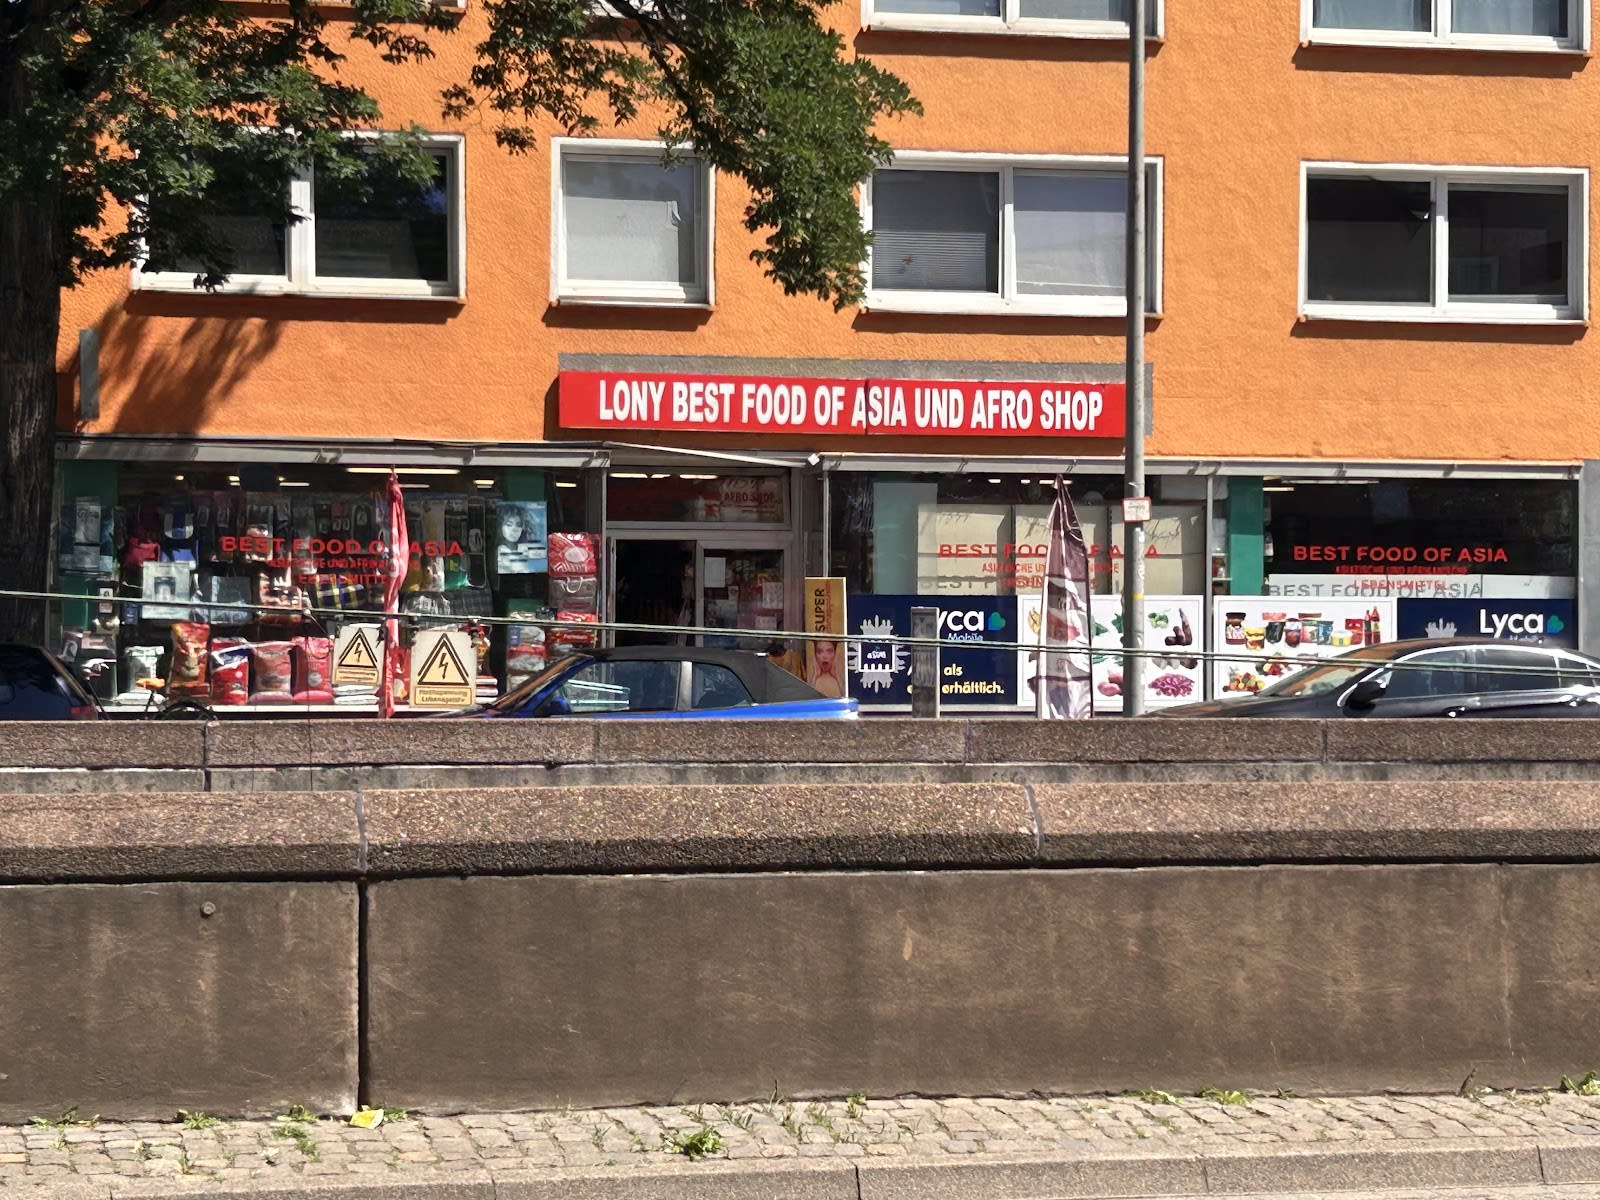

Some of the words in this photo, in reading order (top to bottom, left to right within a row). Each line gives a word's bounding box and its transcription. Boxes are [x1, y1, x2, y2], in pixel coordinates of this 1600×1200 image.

[599, 380, 666, 421] LONY
[672, 382, 736, 424] BEST
[741, 384, 807, 425] FOOD
[813, 386, 846, 427] OF
[851, 386, 908, 428] ASIA
[914, 387, 966, 427] UND
[970, 388, 1033, 430] AFRO
[1039, 390, 1103, 432] SHOP
[222, 536, 286, 553] BEST
[294, 538, 362, 555] FOOD
[409, 542, 464, 558] ASIA
[939, 544, 997, 559] BEST
[1003, 543, 1049, 559] FOO
[1108, 544, 1160, 560] AA
[1293, 546, 1348, 561] BEST
[1356, 546, 1417, 563] FOOD
[1422, 547, 1451, 563] OF
[1455, 547, 1509, 563] ASIA
[814, 588, 826, 633] SUPER
[1480, 608, 1544, 639] Lyca
[943, 664, 964, 677] als
[942, 681, 1005, 695] erhältlich.
